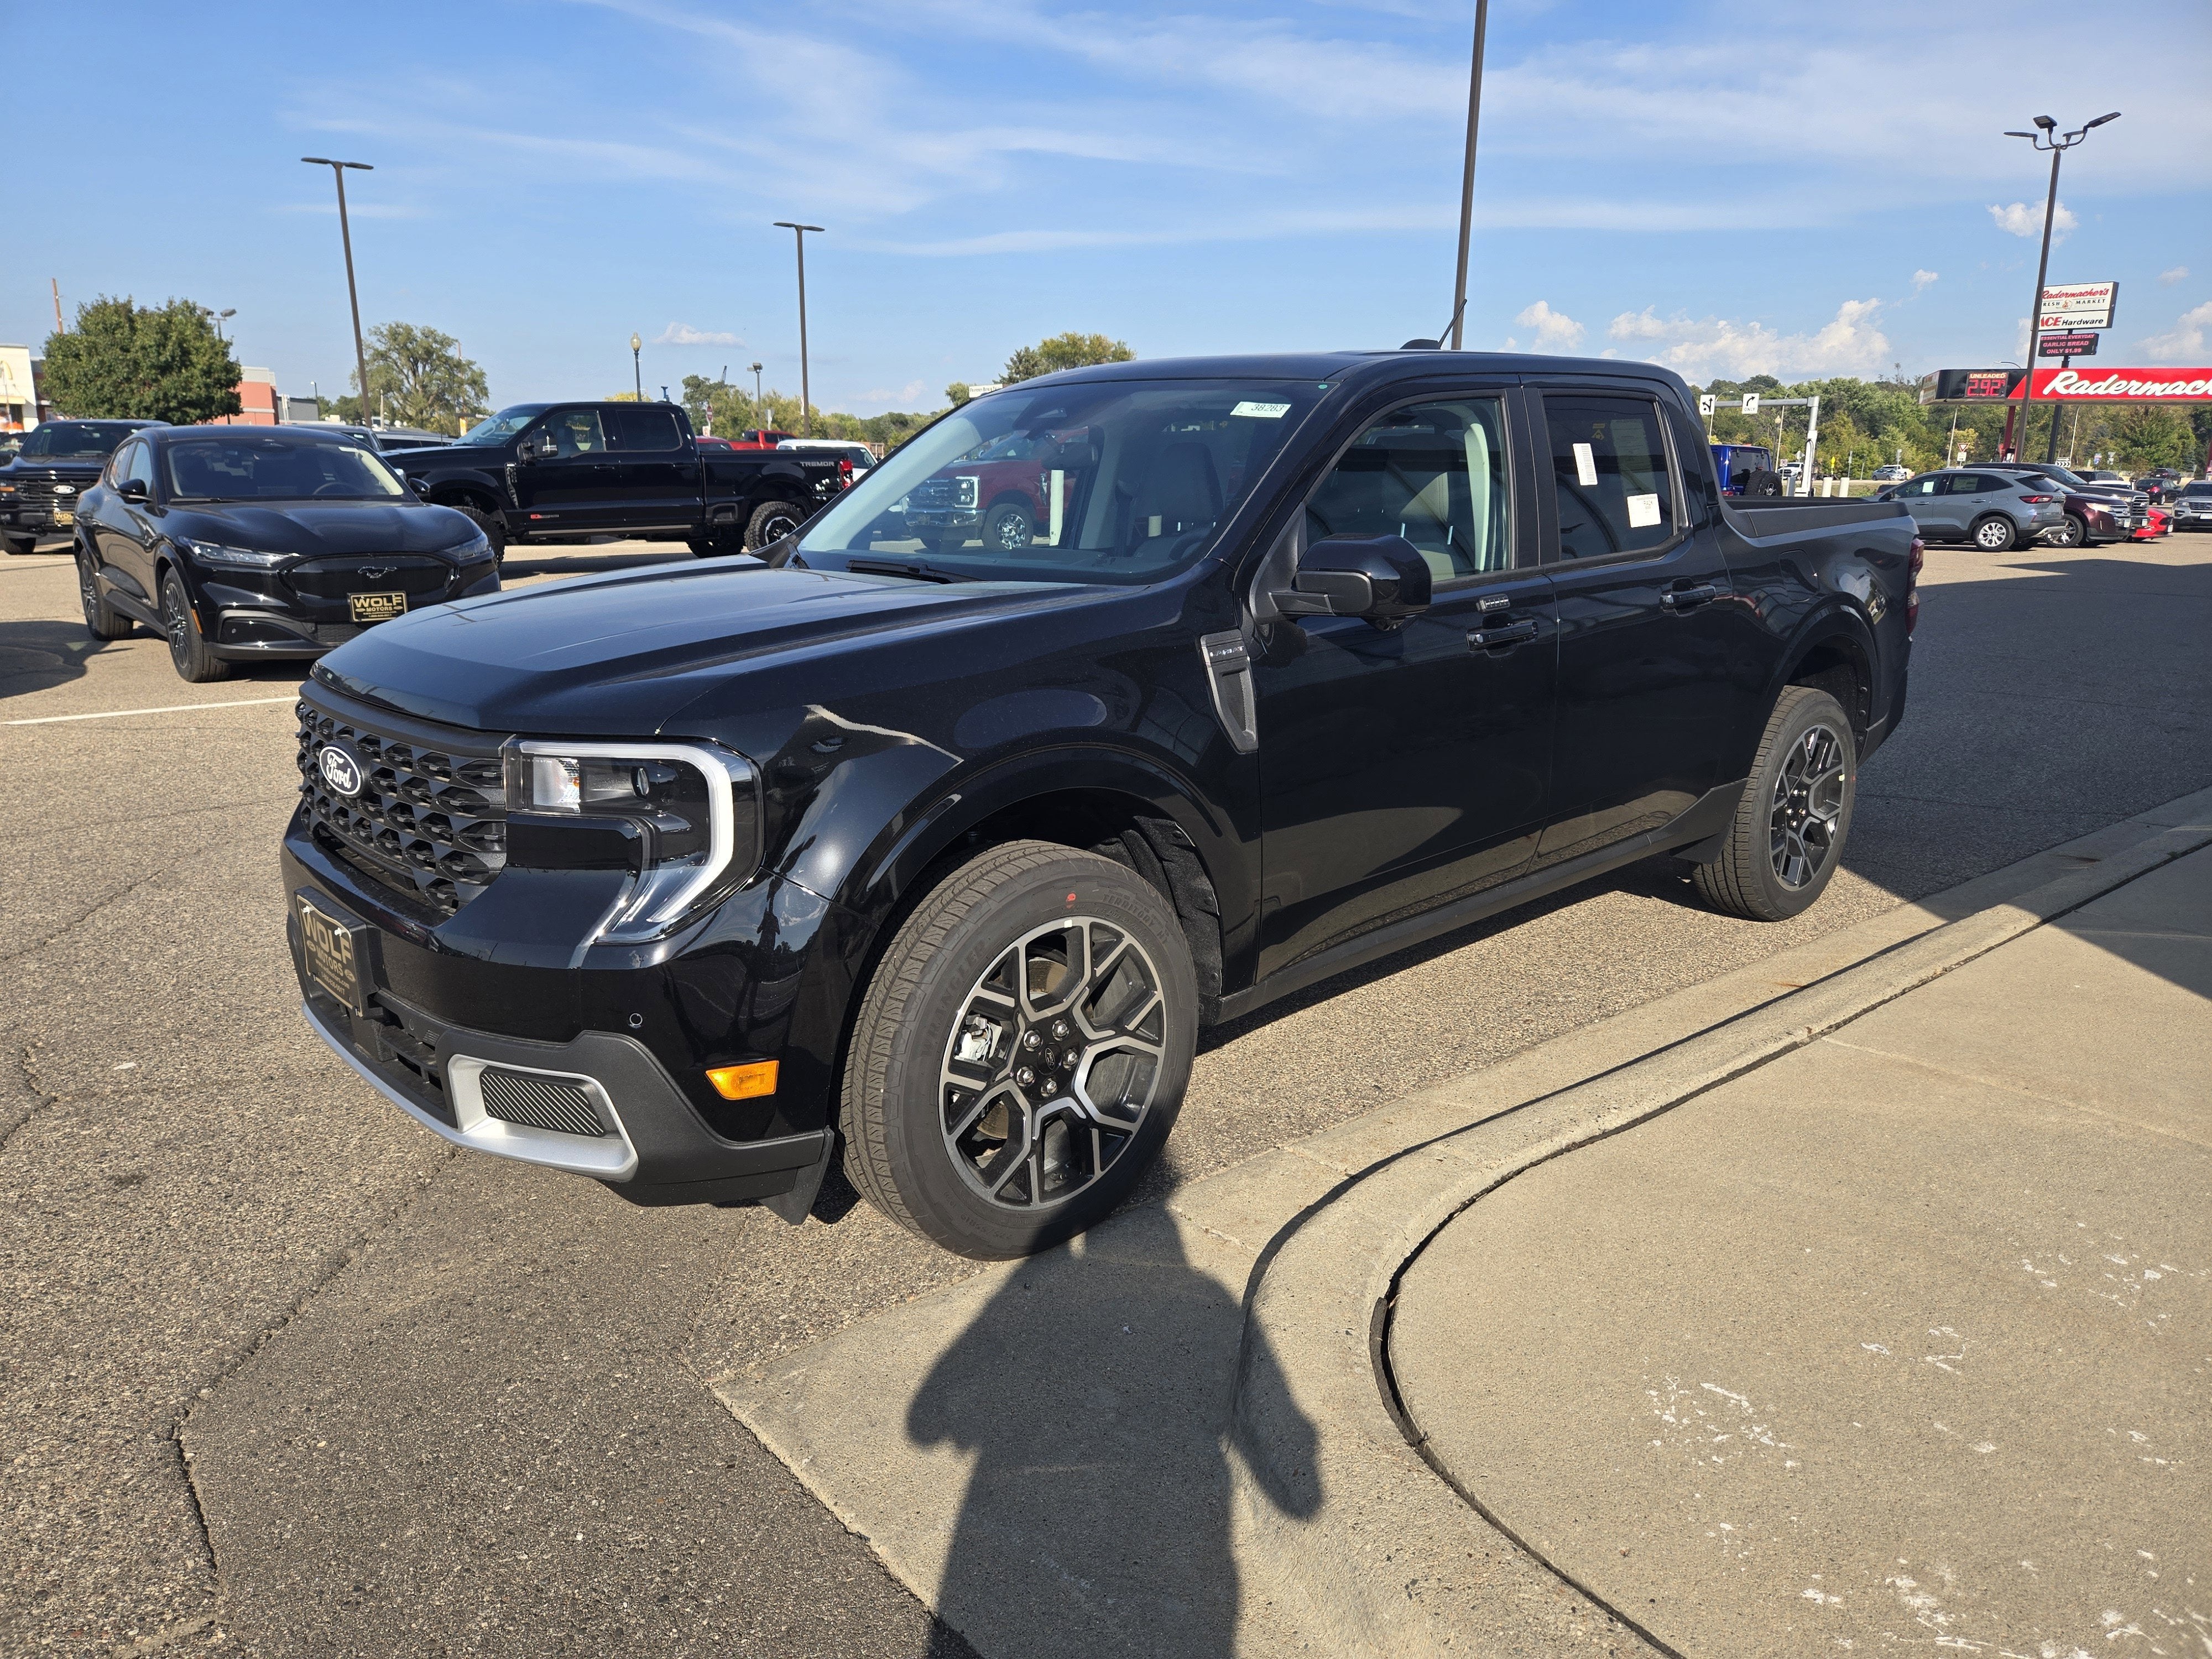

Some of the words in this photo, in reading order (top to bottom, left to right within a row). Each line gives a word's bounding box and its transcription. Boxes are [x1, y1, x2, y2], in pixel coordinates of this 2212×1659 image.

[1251, 404, 1285, 412] 38283
[354, 597, 402, 607] WOLF
[326, 752, 352, 789] Ford
[1102, 891, 1155, 930] TERRITORY
[301, 908, 352, 964] WOLF
[315, 945, 344, 977] MOTORS
